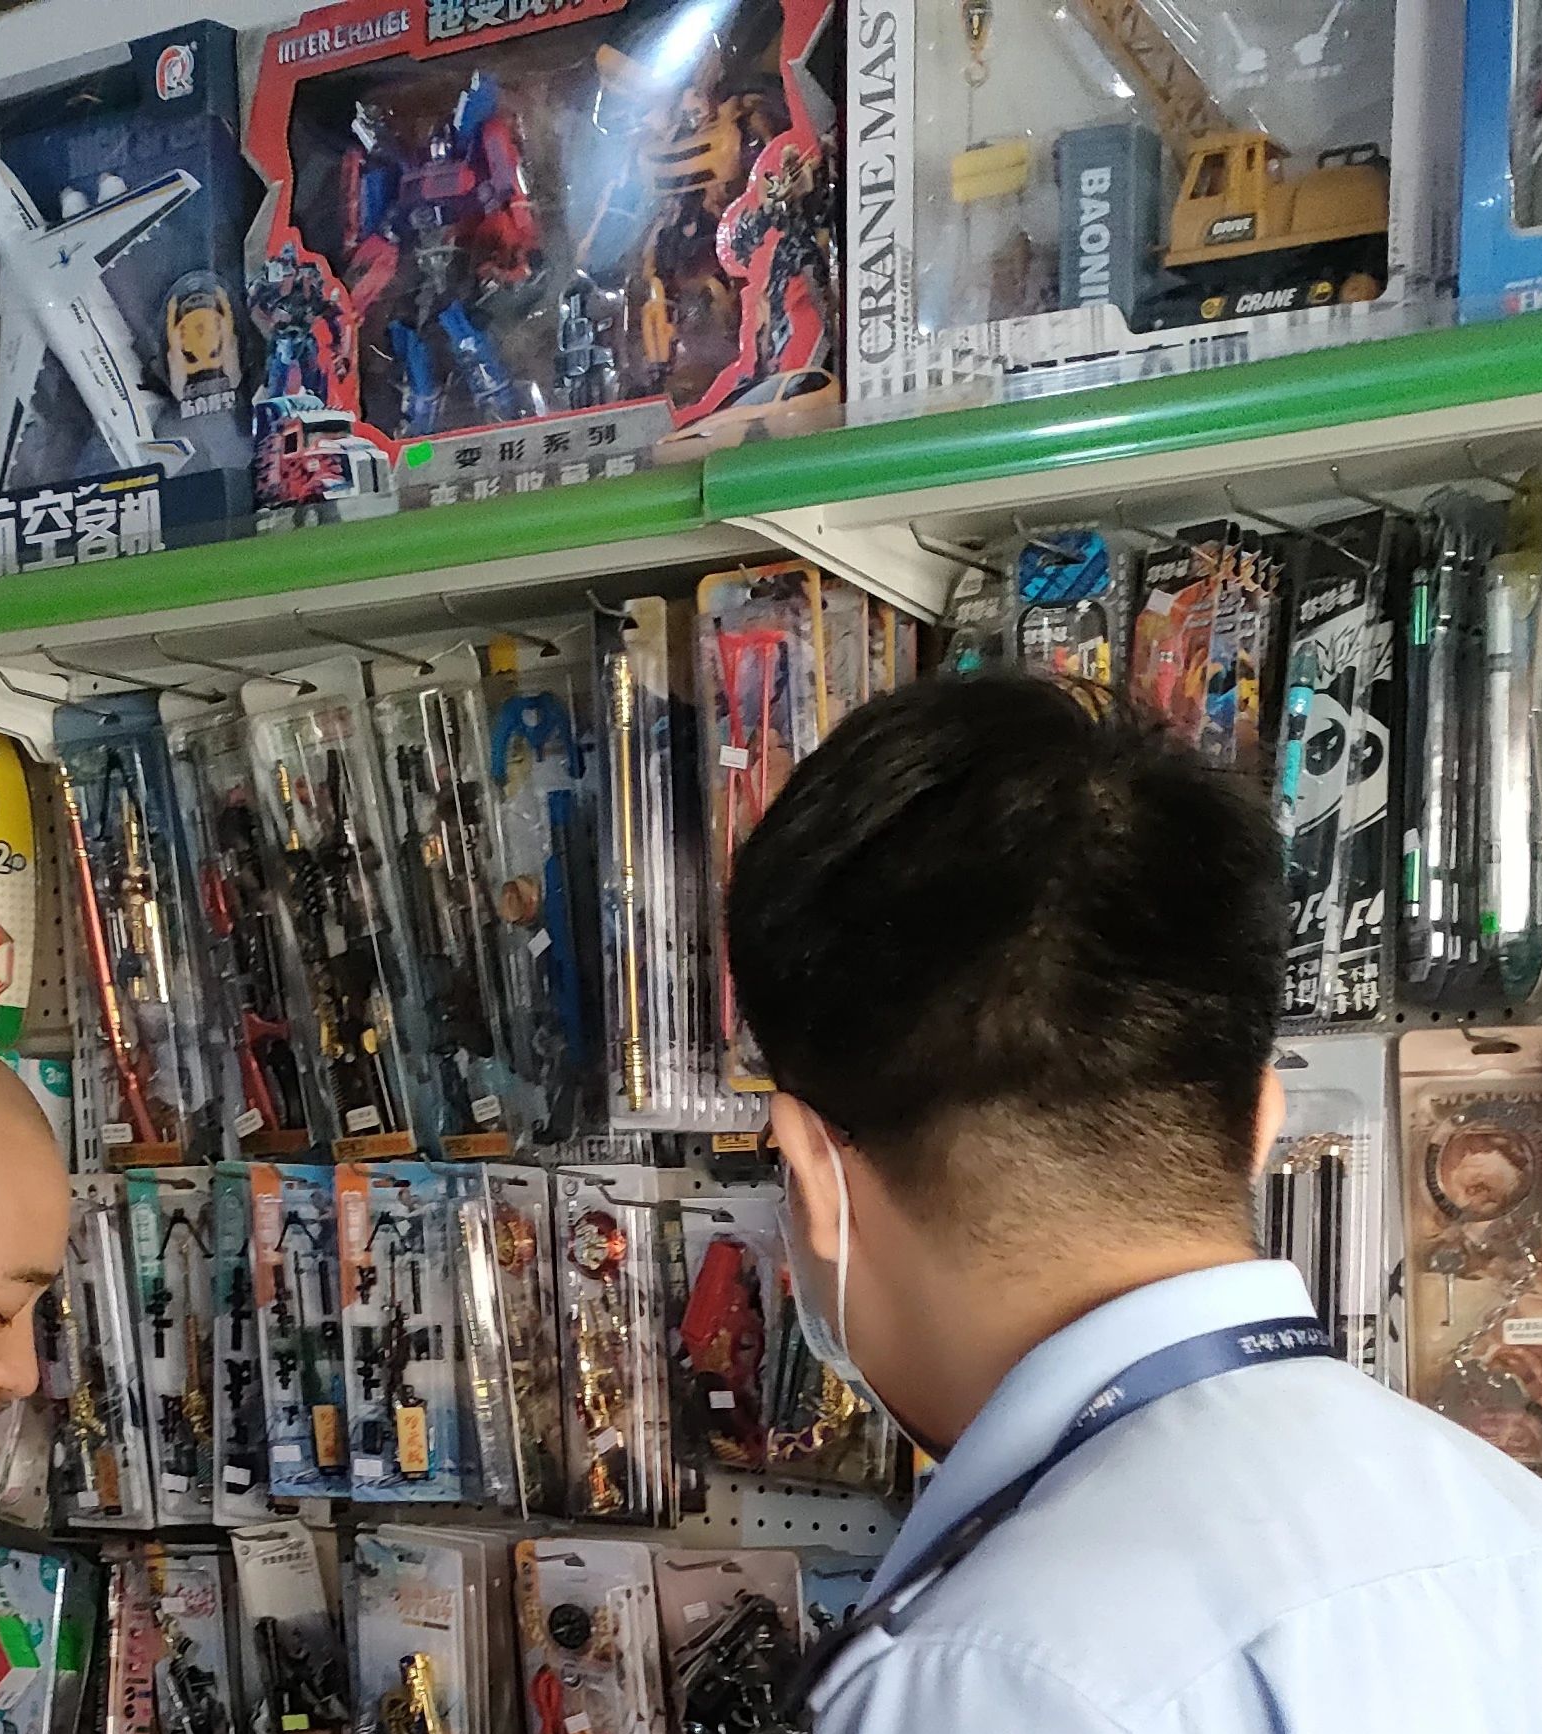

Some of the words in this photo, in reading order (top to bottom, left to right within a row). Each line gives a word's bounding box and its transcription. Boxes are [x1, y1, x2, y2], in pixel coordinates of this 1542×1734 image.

[858, 152, 897, 365] CRANE
[1235, 288, 1298, 313] CRANE
[455, 422, 619, 470] 变形系列
